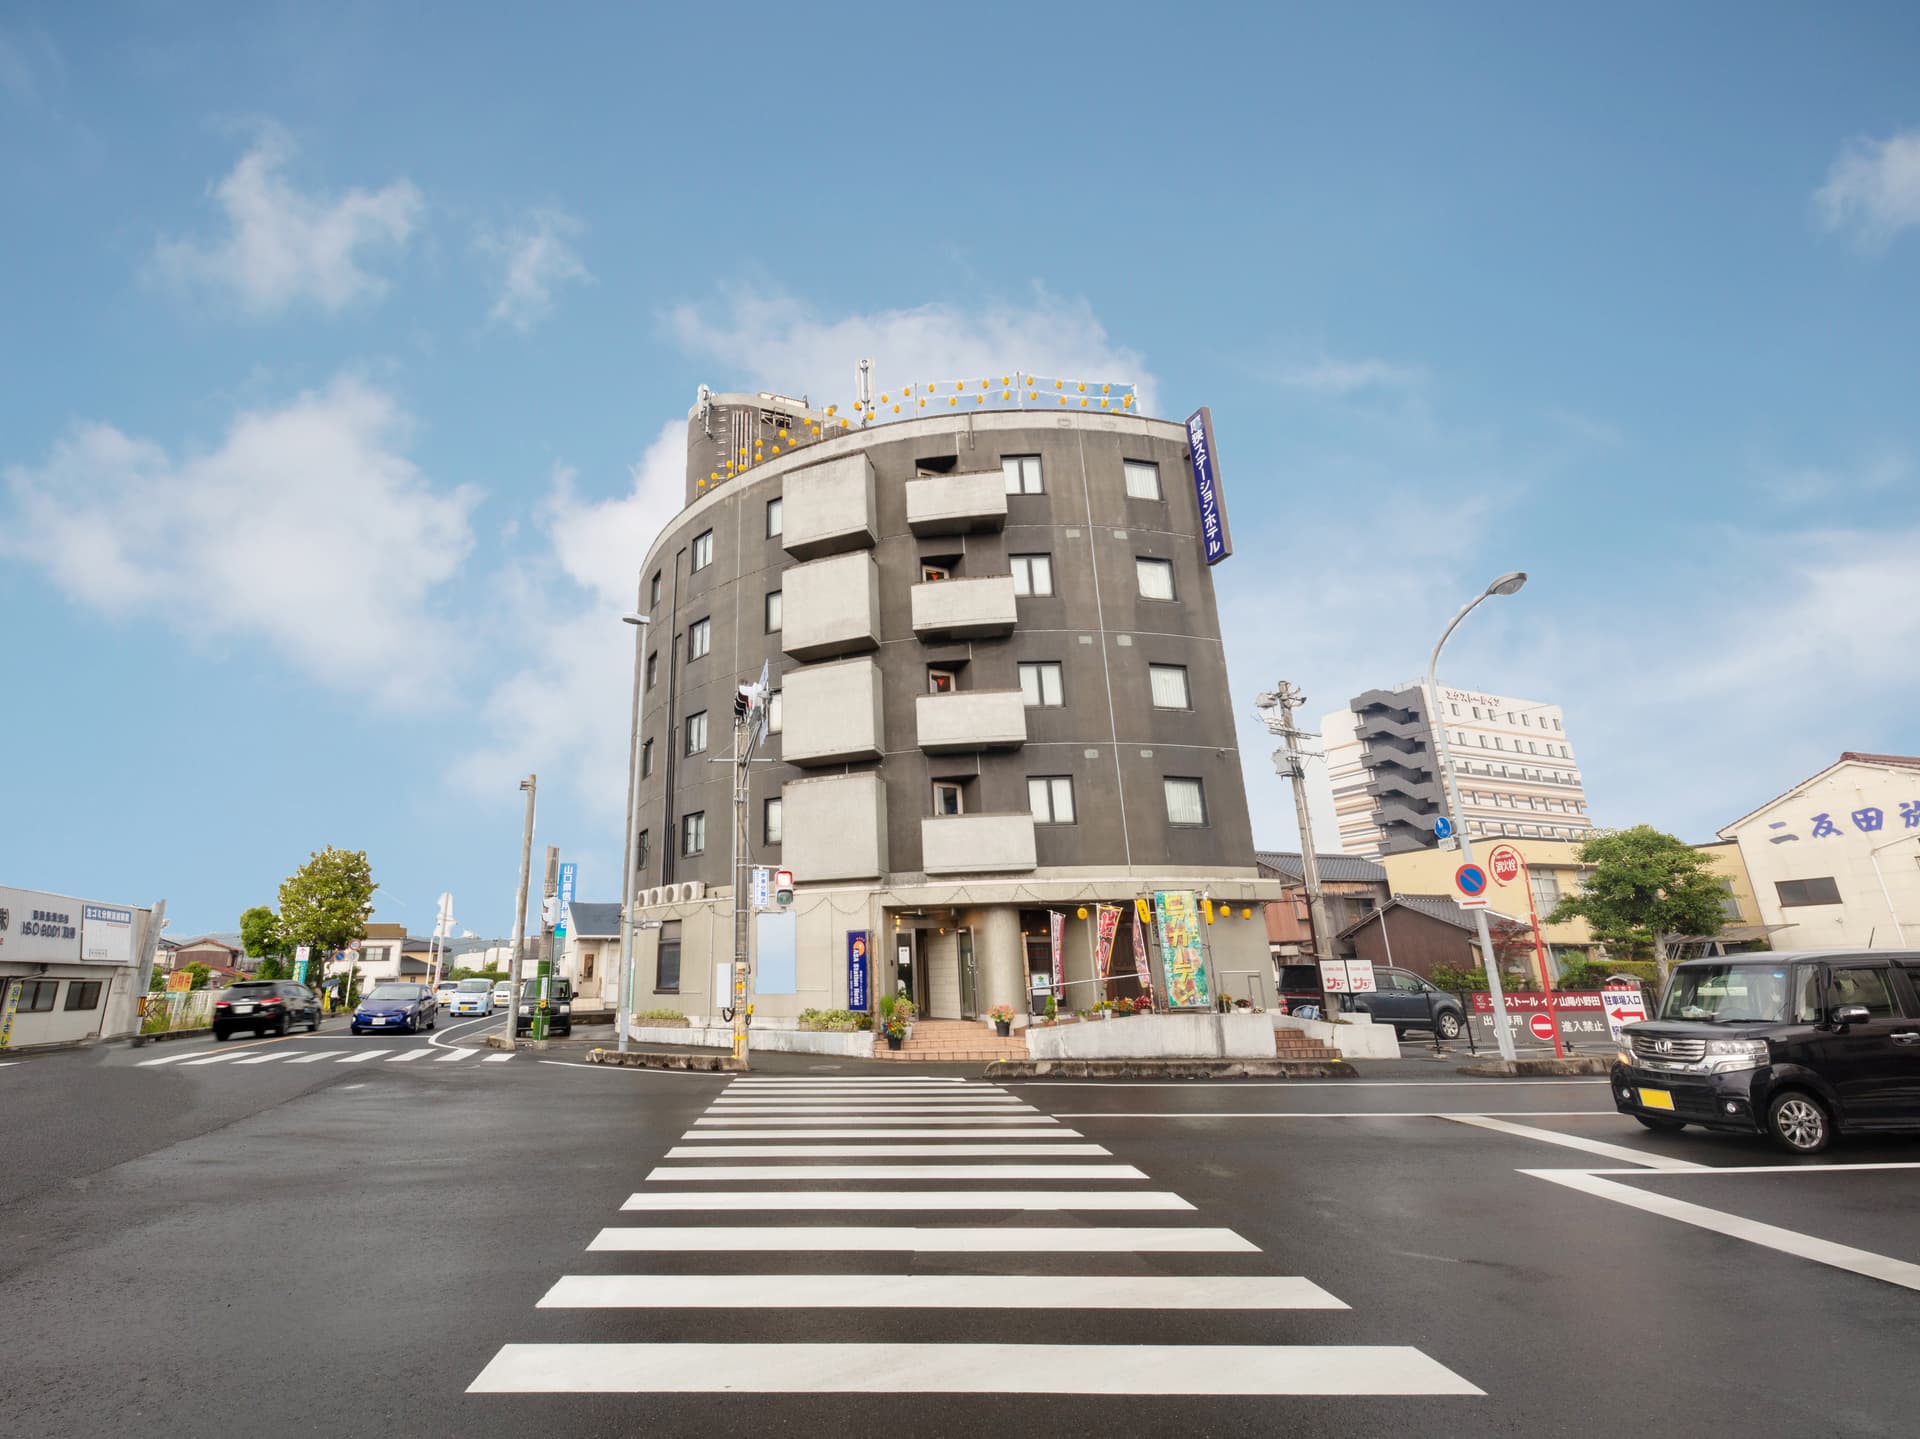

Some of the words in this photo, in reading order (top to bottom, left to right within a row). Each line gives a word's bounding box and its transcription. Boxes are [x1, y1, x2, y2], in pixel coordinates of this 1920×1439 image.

[1495, 858, 1517, 873] 消火栓
[1164, 894, 1195, 1004] ビアガーデン
[1604, 995, 1640, 1006] 駐車場入口
[1561, 1021, 1605, 1032] 進入禁止
